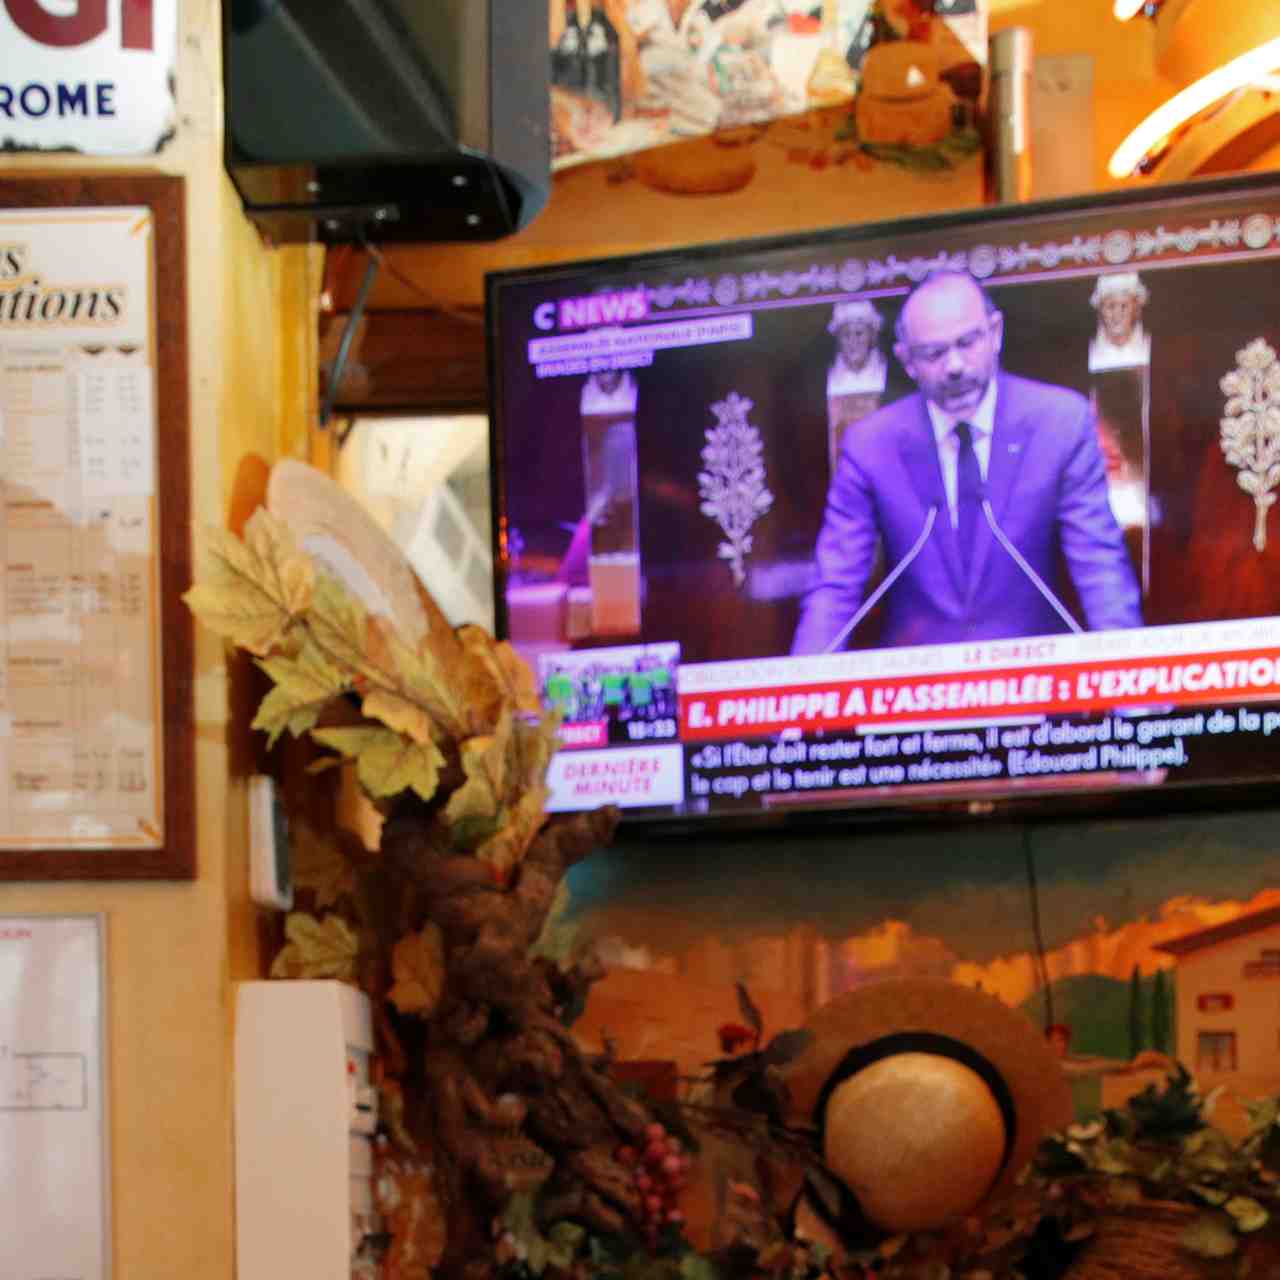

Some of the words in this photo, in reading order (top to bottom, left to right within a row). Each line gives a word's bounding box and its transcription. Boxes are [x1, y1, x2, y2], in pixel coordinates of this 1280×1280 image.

[560, 290, 648, 327] NEWS
[687, 701, 713, 729] E.
[718, 690, 840, 727] PHILIPPE
[872, 672, 1054, 716] L'ASSEMBLÉE
[1136, 712, 1205, 744] garant
[1206, 708, 1237, 734] de
[1238, 706, 1261, 732] la
